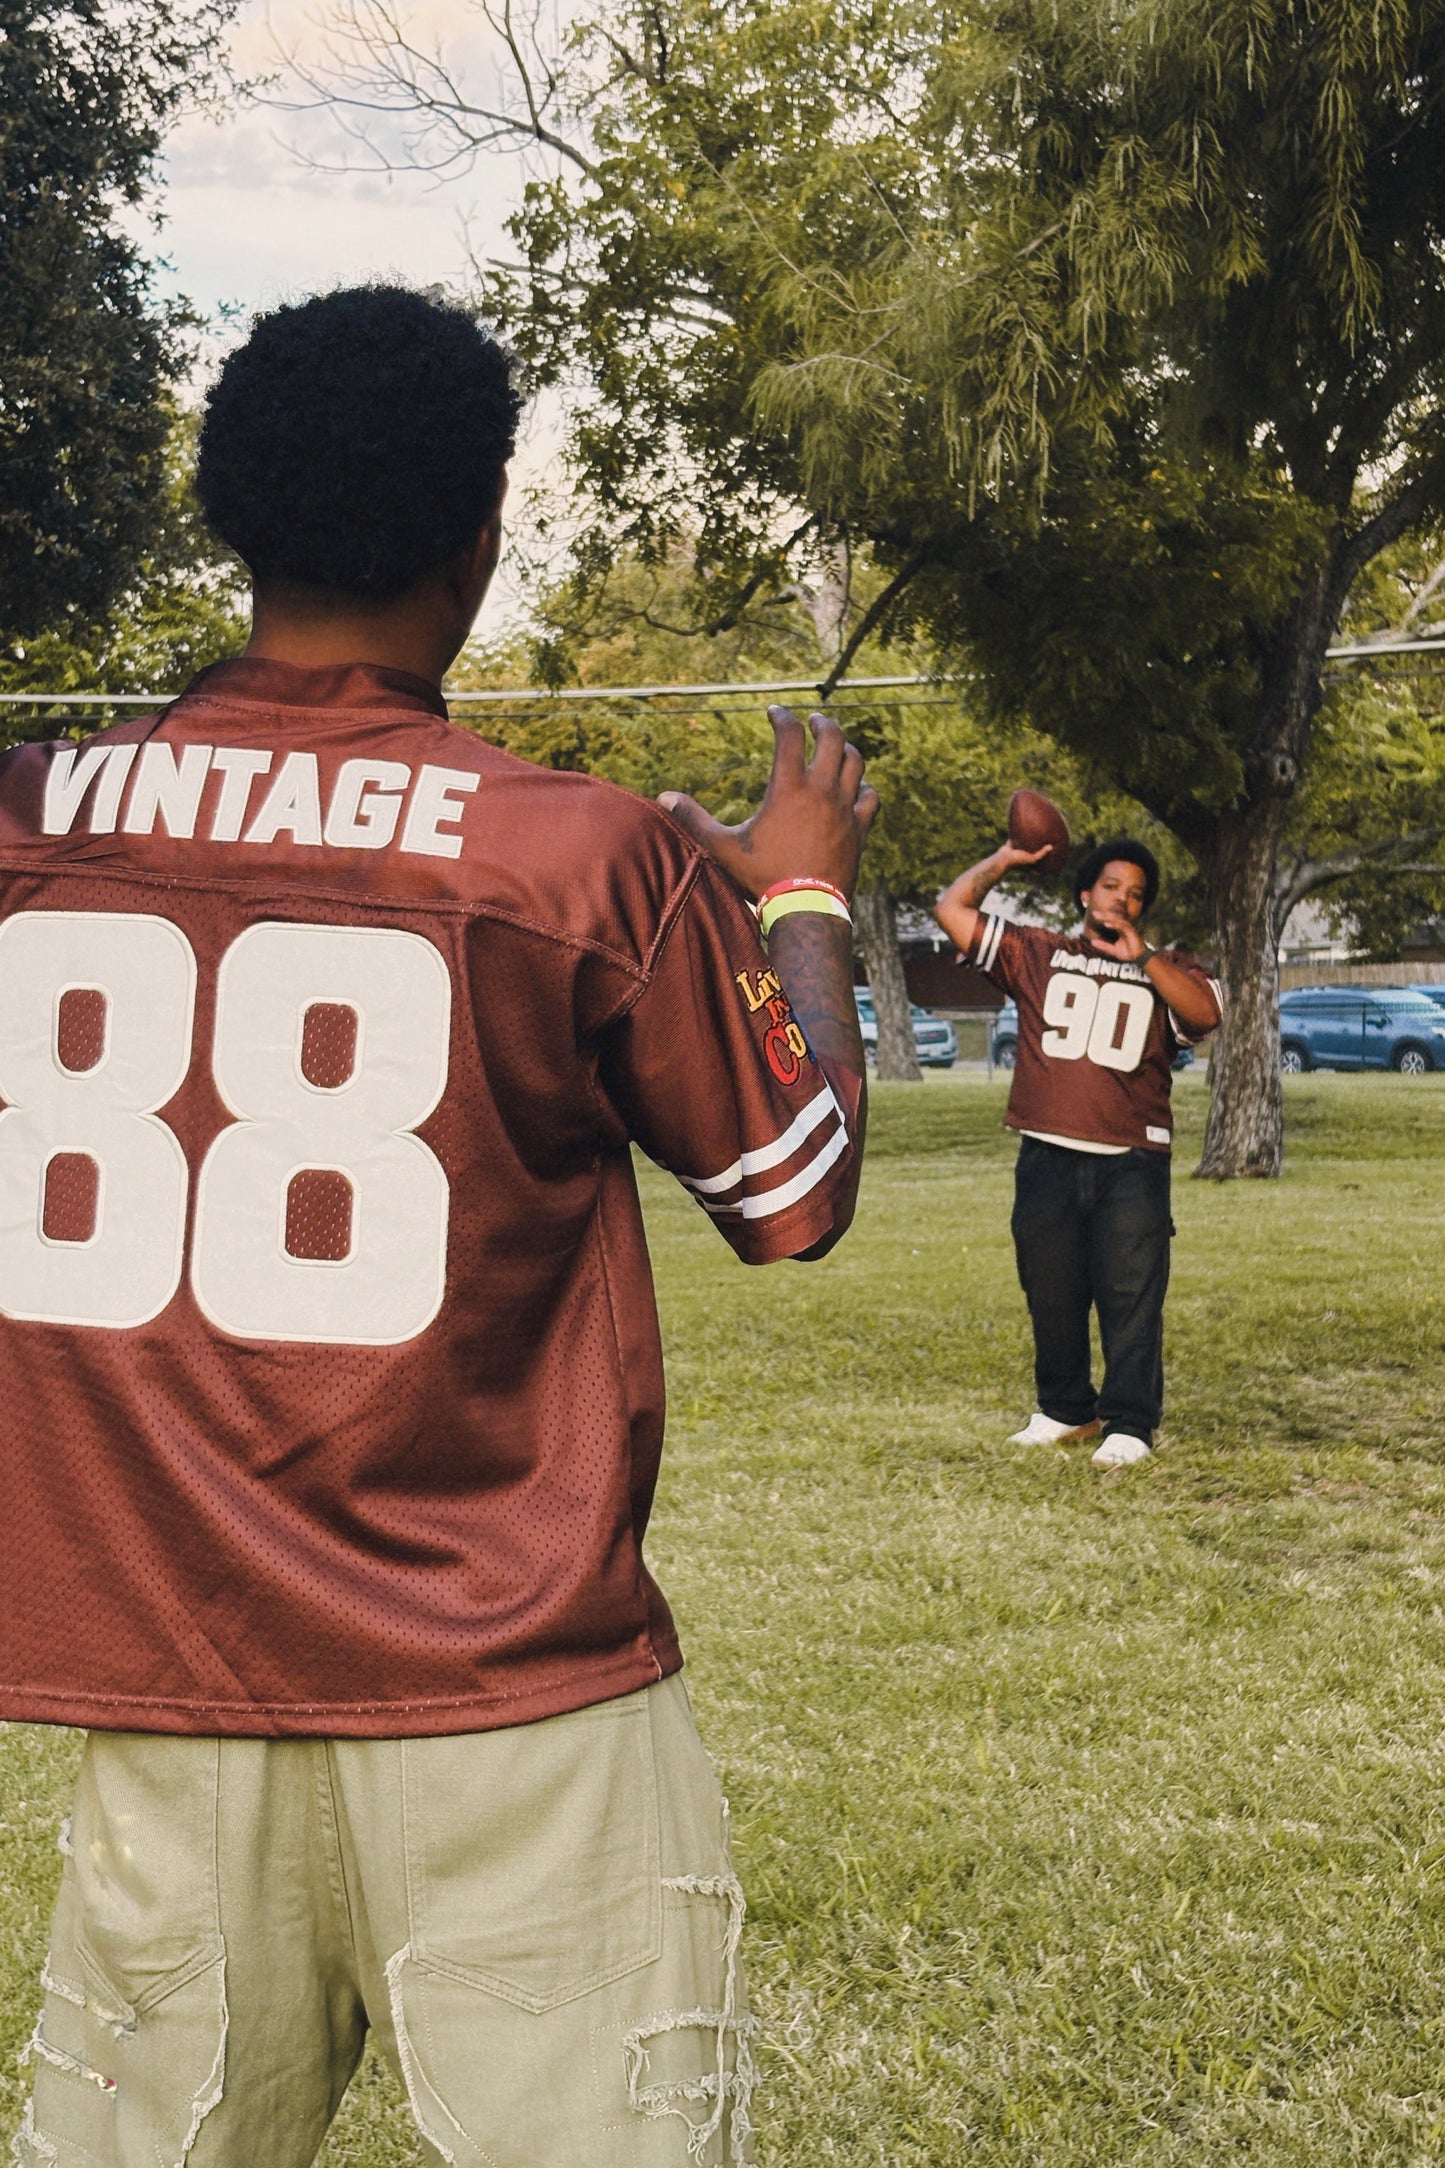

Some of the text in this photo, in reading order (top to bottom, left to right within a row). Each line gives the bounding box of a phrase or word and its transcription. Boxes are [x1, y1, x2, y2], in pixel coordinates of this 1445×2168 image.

[42, 742, 481, 859] VINTAGE
[1041, 972, 1154, 1073] 90
[0, 911, 452, 1346] 88
